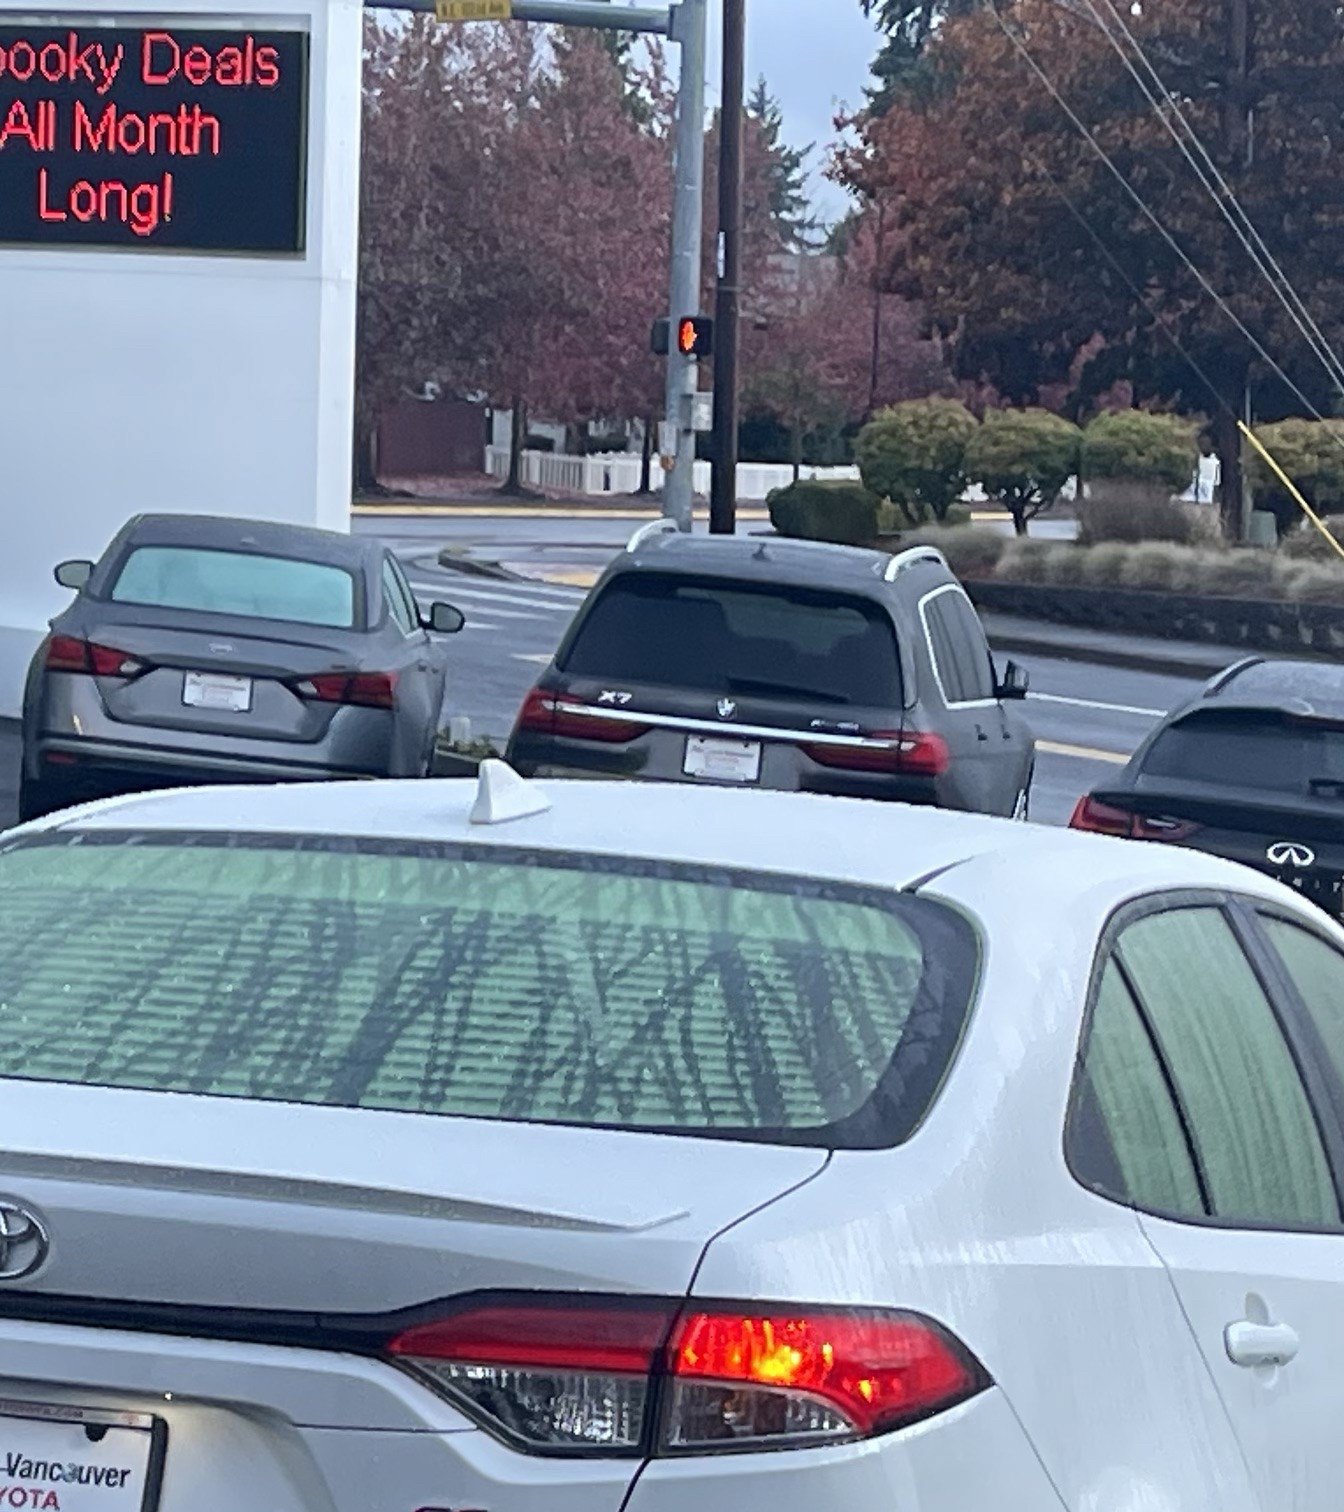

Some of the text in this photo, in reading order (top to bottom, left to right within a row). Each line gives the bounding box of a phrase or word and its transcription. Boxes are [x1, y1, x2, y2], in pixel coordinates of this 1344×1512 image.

[142, 31, 280, 87] Deals
[74, 99, 221, 156] Month
[39, 166, 173, 237] Long!
[598, 690, 632, 704] X7
